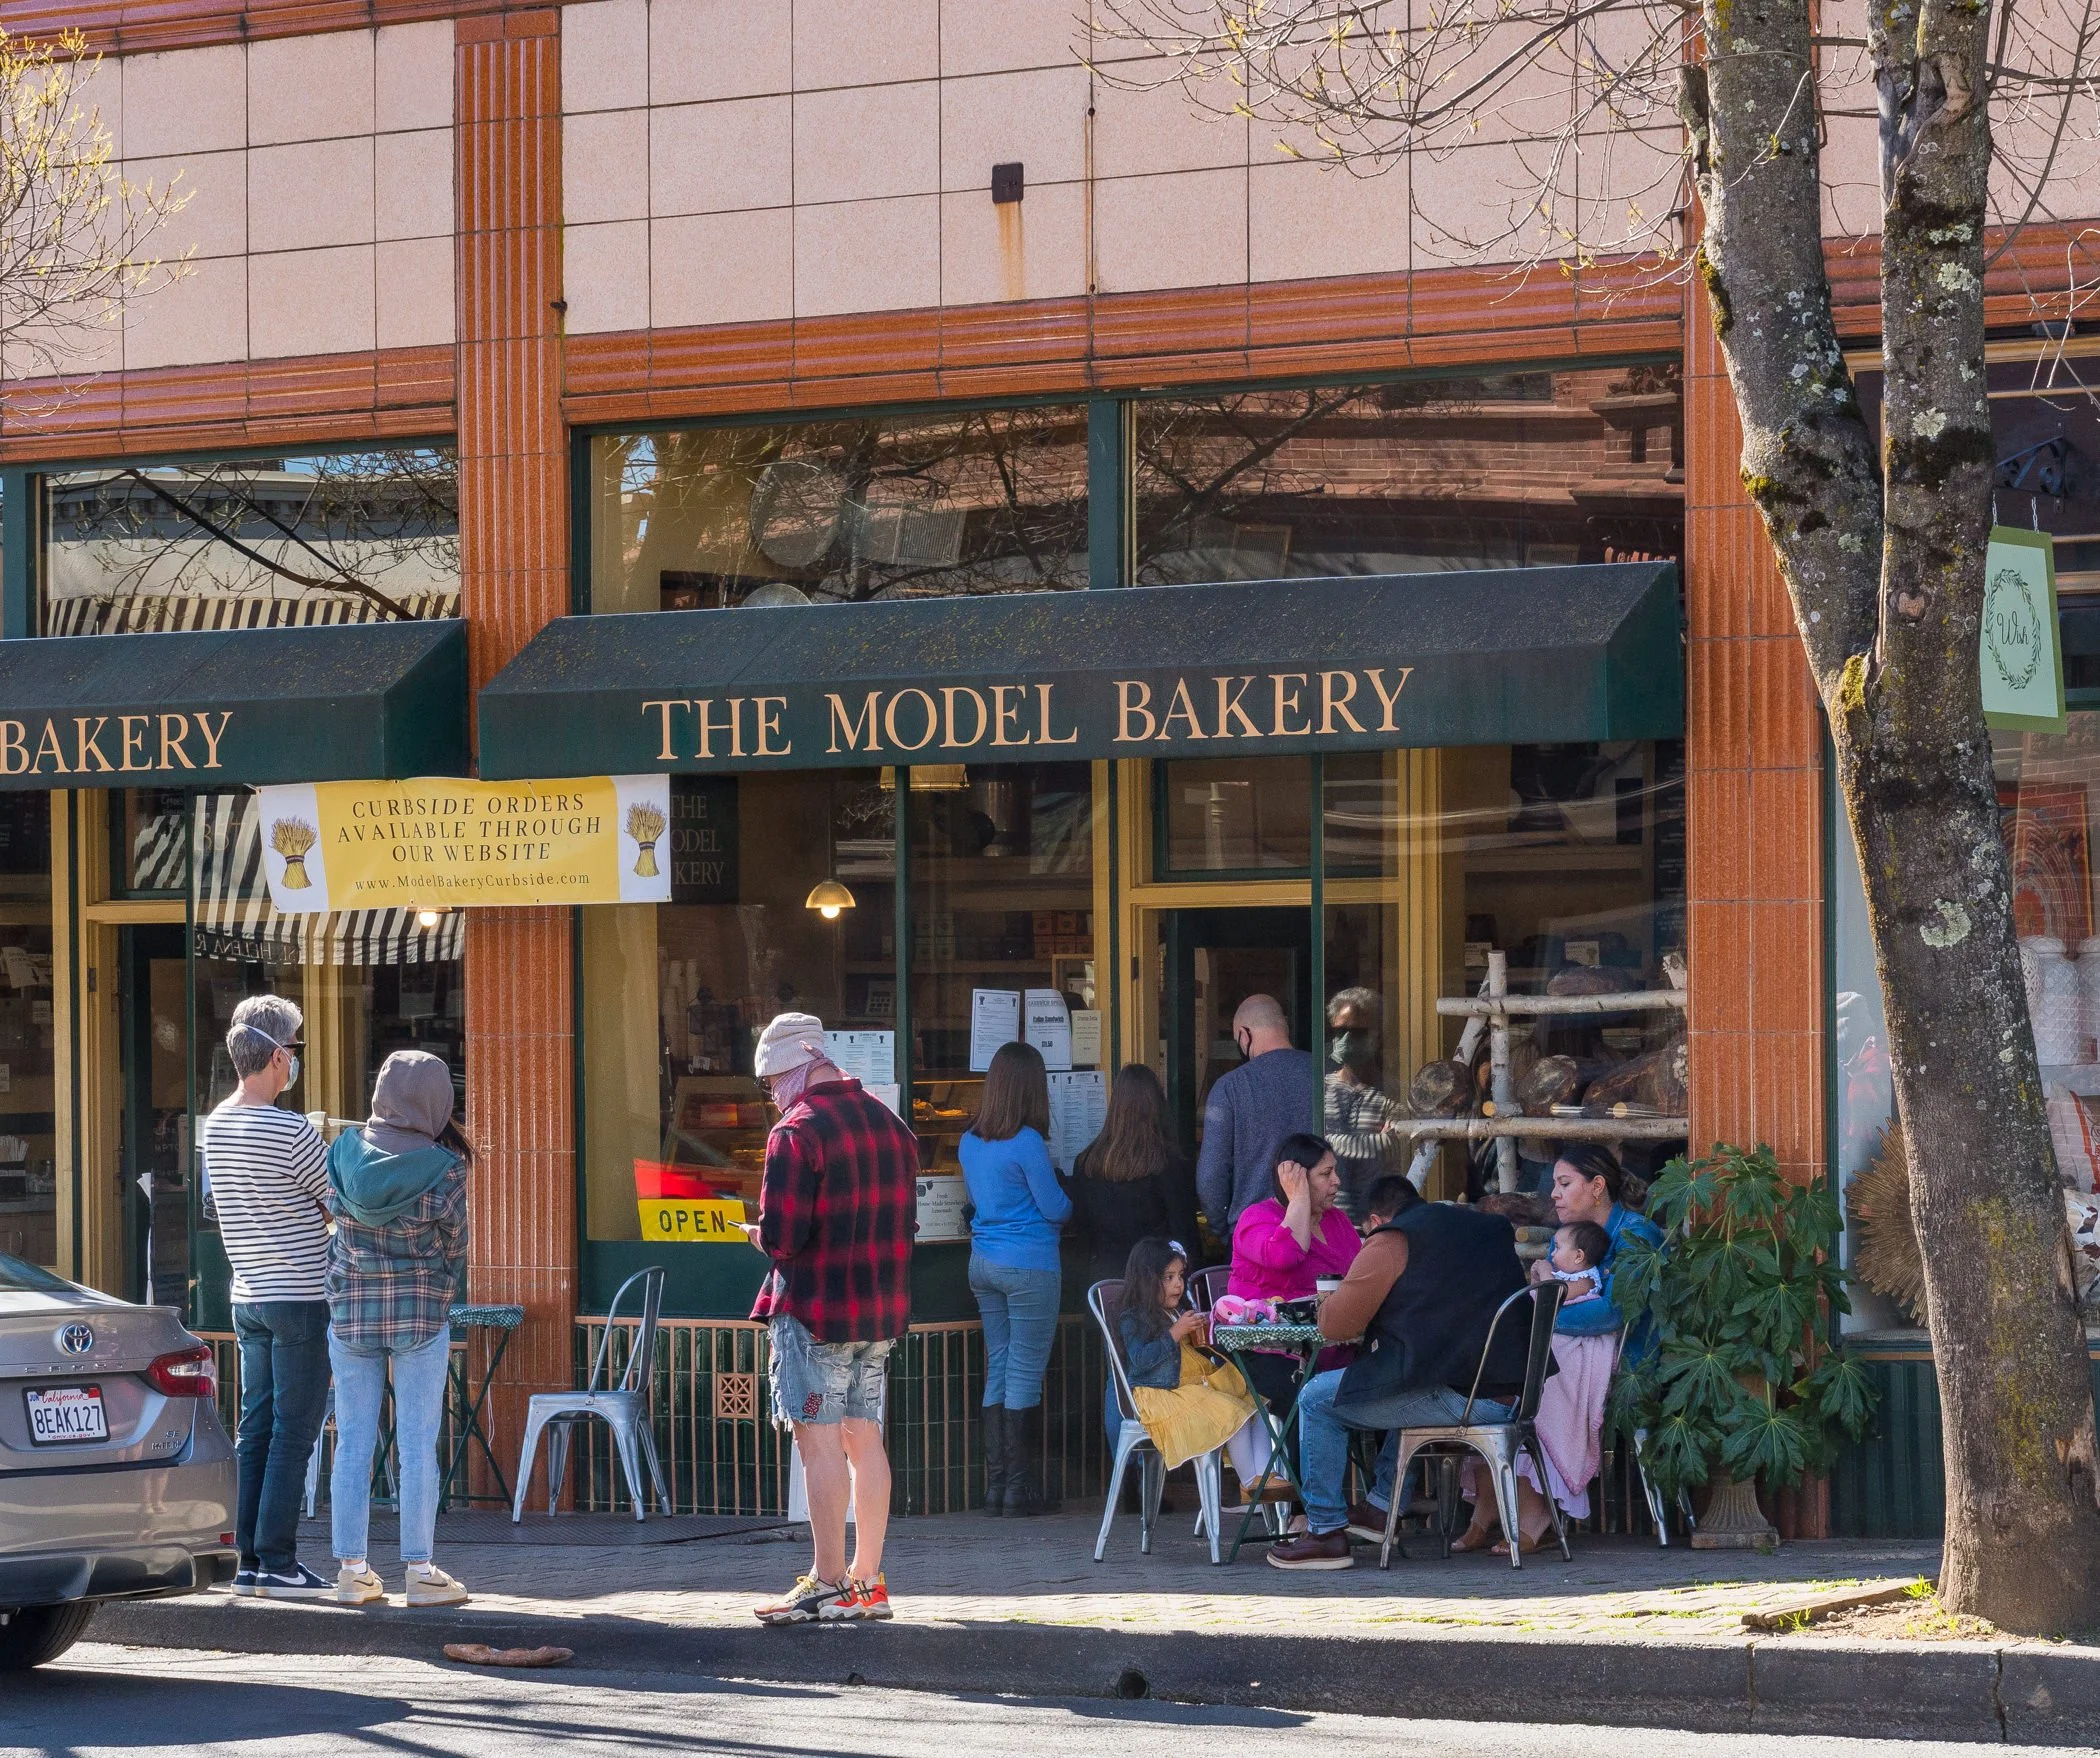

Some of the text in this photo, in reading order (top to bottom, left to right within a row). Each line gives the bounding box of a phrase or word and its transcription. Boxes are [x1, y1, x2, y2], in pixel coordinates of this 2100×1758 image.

[1996, 610, 2030, 646] Wish
[641, 667, 1415, 761] THE MODEL BAKERY
[0, 711, 234, 775] BAKERY
[352, 793, 584, 819] CURBSIDE ORDERS
[670, 794, 708, 819] THE
[337, 816, 601, 843] AVAILABLE THROUGH
[670, 828, 721, 853] ODEL
[392, 842, 551, 862] OUR WEBSITE
[355, 872, 591, 891] www.ModelBakeryCurbside.com
[671, 861, 726, 885] KERY
[659, 1209, 726, 1233] OPEN
[42, 1391, 84, 1406] California
[34, 1405, 102, 1434] 8EAK127
